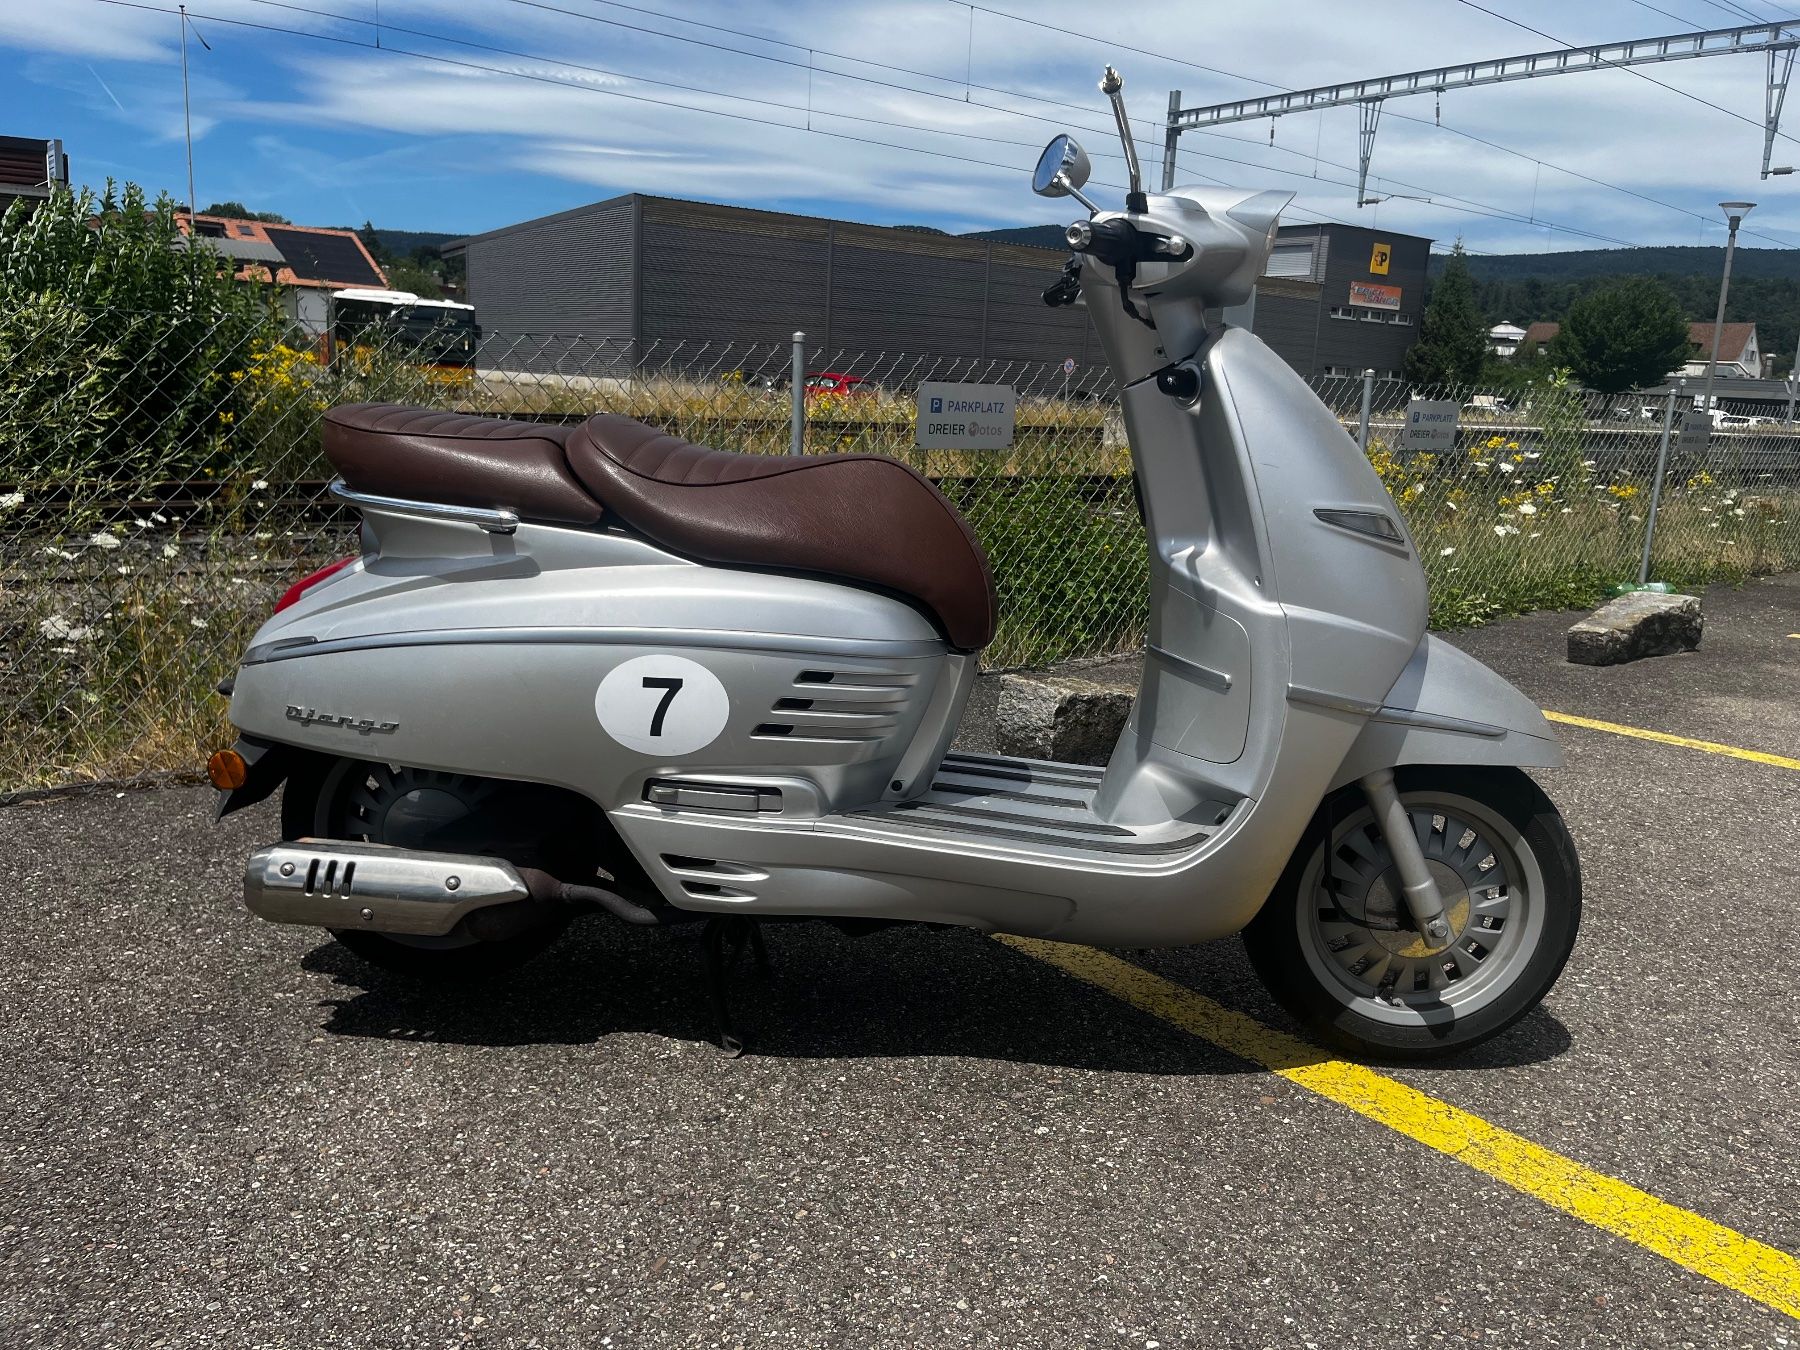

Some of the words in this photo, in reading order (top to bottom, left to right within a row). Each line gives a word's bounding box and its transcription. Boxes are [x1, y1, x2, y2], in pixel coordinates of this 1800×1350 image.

[932, 399, 941, 412] P
[948, 400, 1004, 414] PARKPLATZ
[928, 423, 965, 435] DREIER
[642, 676, 683, 737] 7
[286, 704, 399, 736] Django
